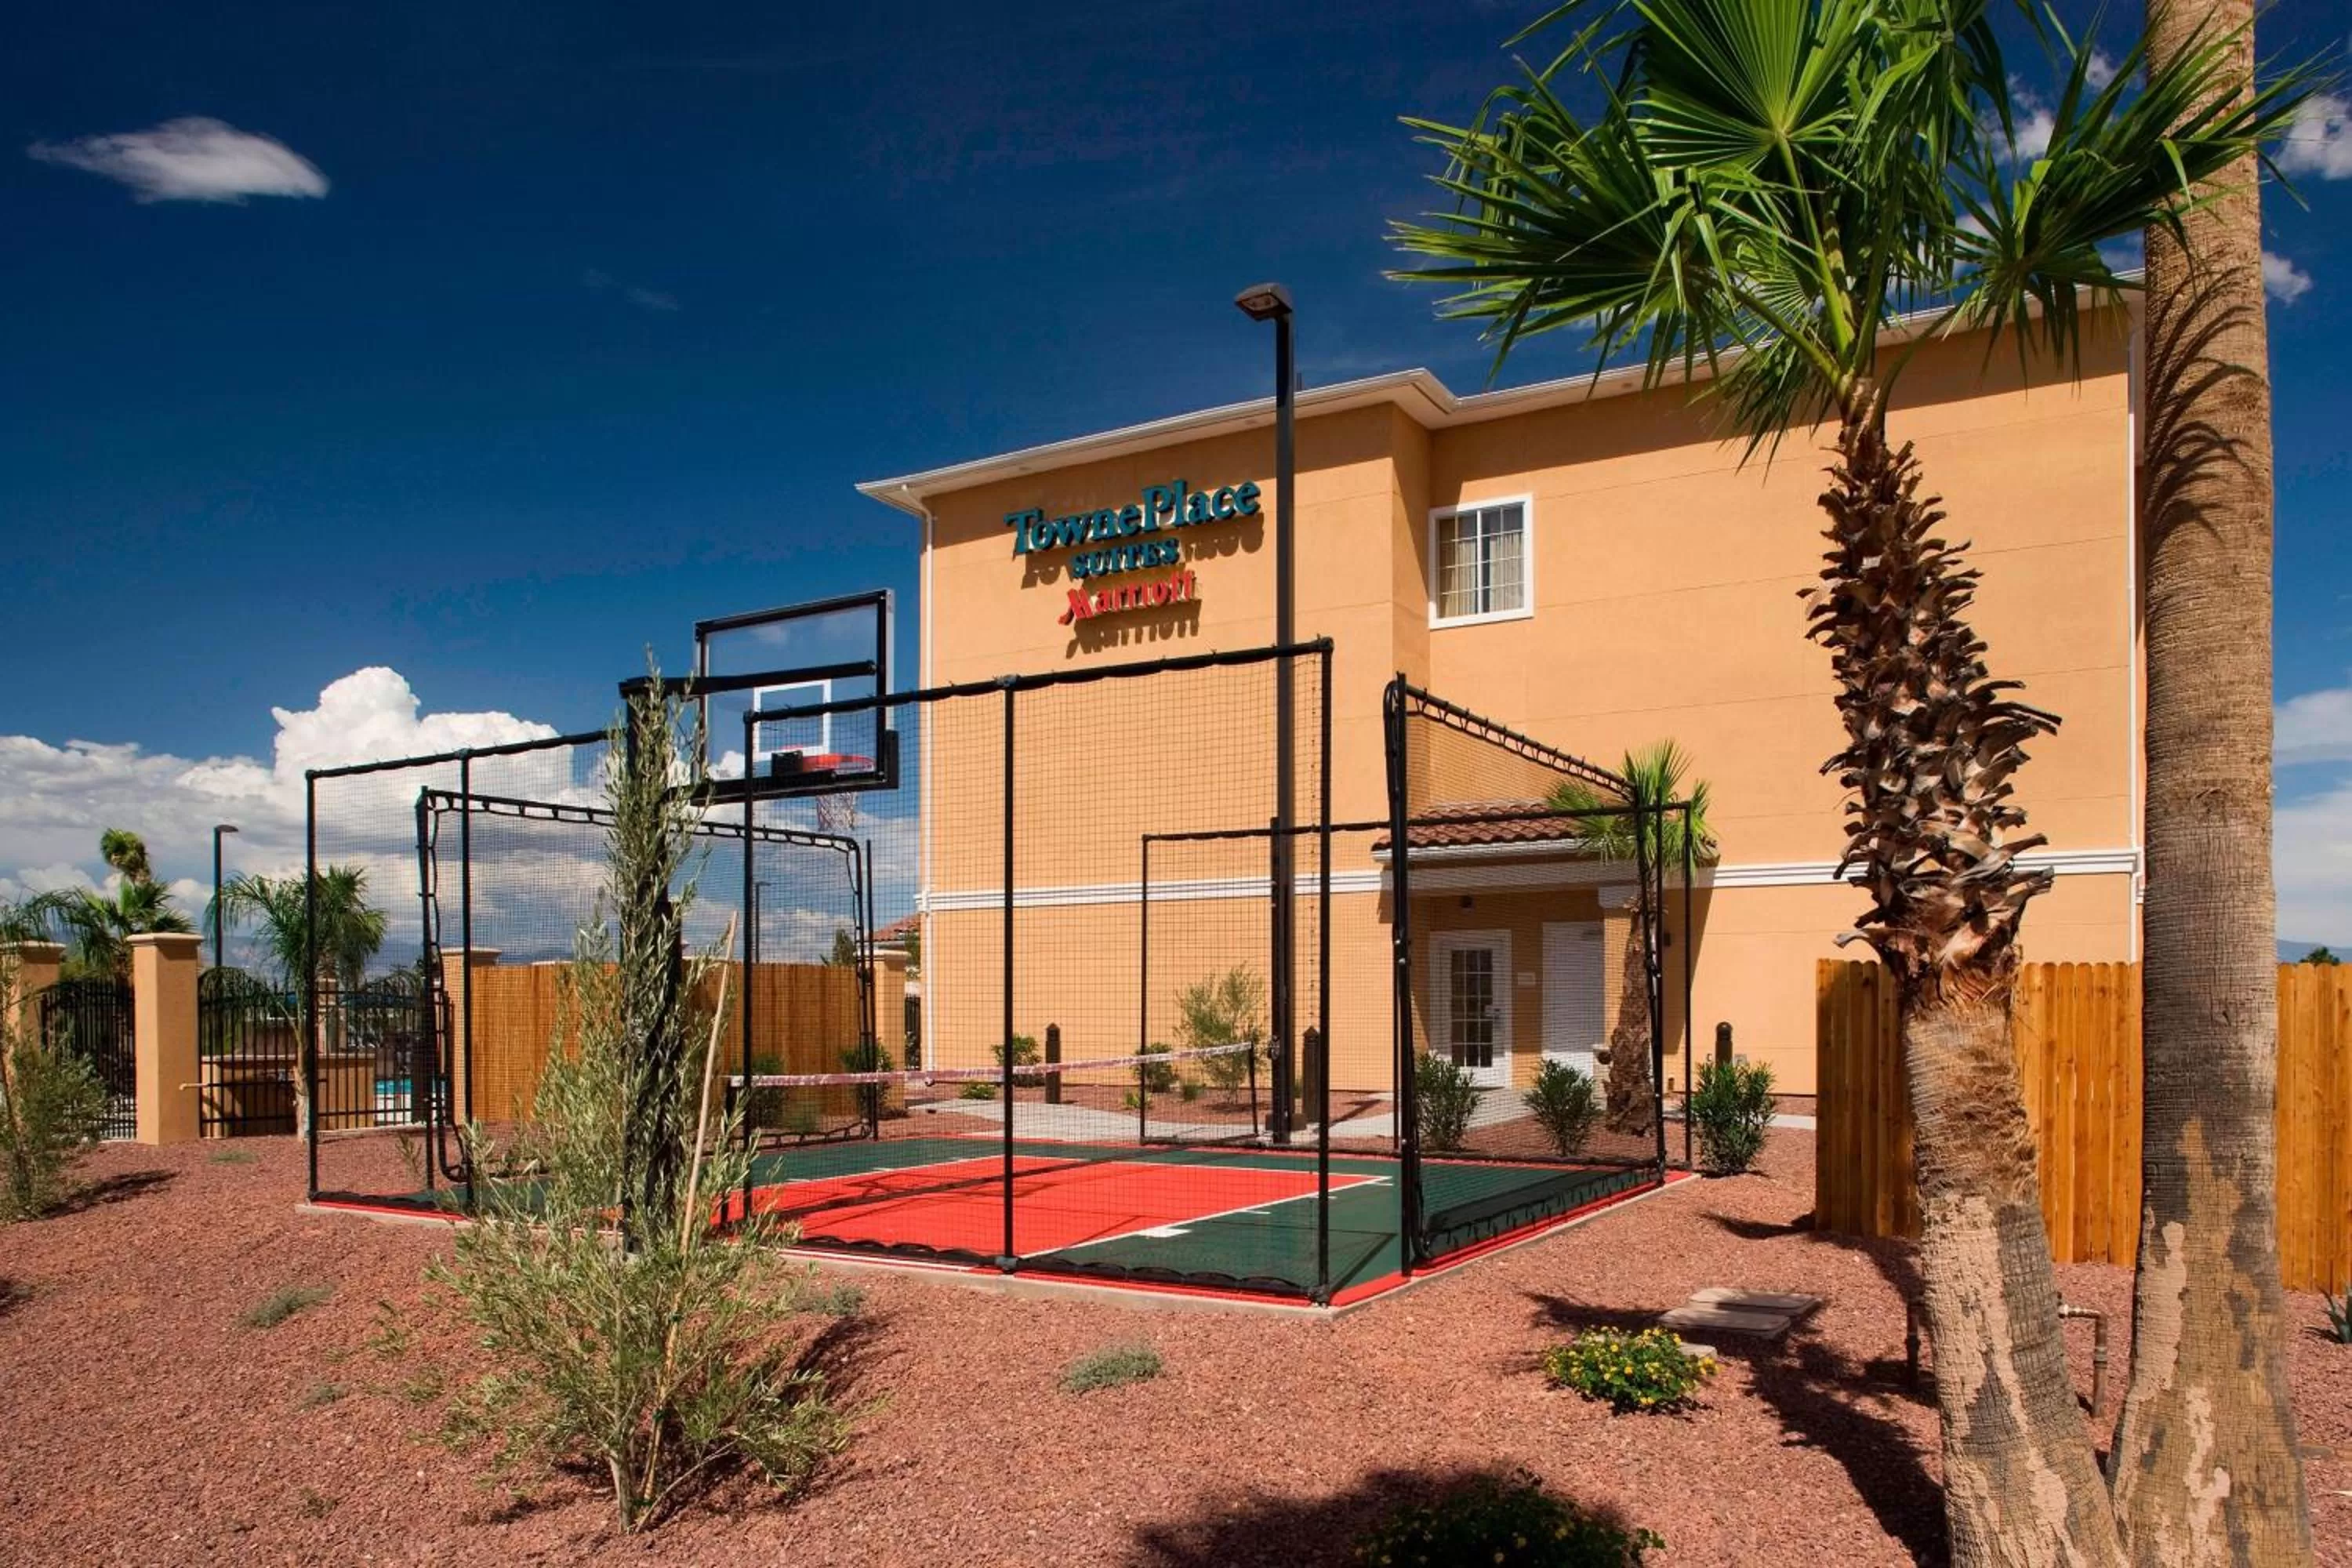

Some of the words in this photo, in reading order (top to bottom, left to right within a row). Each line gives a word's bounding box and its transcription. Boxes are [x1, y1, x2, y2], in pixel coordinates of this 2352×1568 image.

[1004, 478, 1261, 555] TownePlace
[1071, 538, 1180, 578] SUITES
[1058, 569, 1196, 626] Marriott
